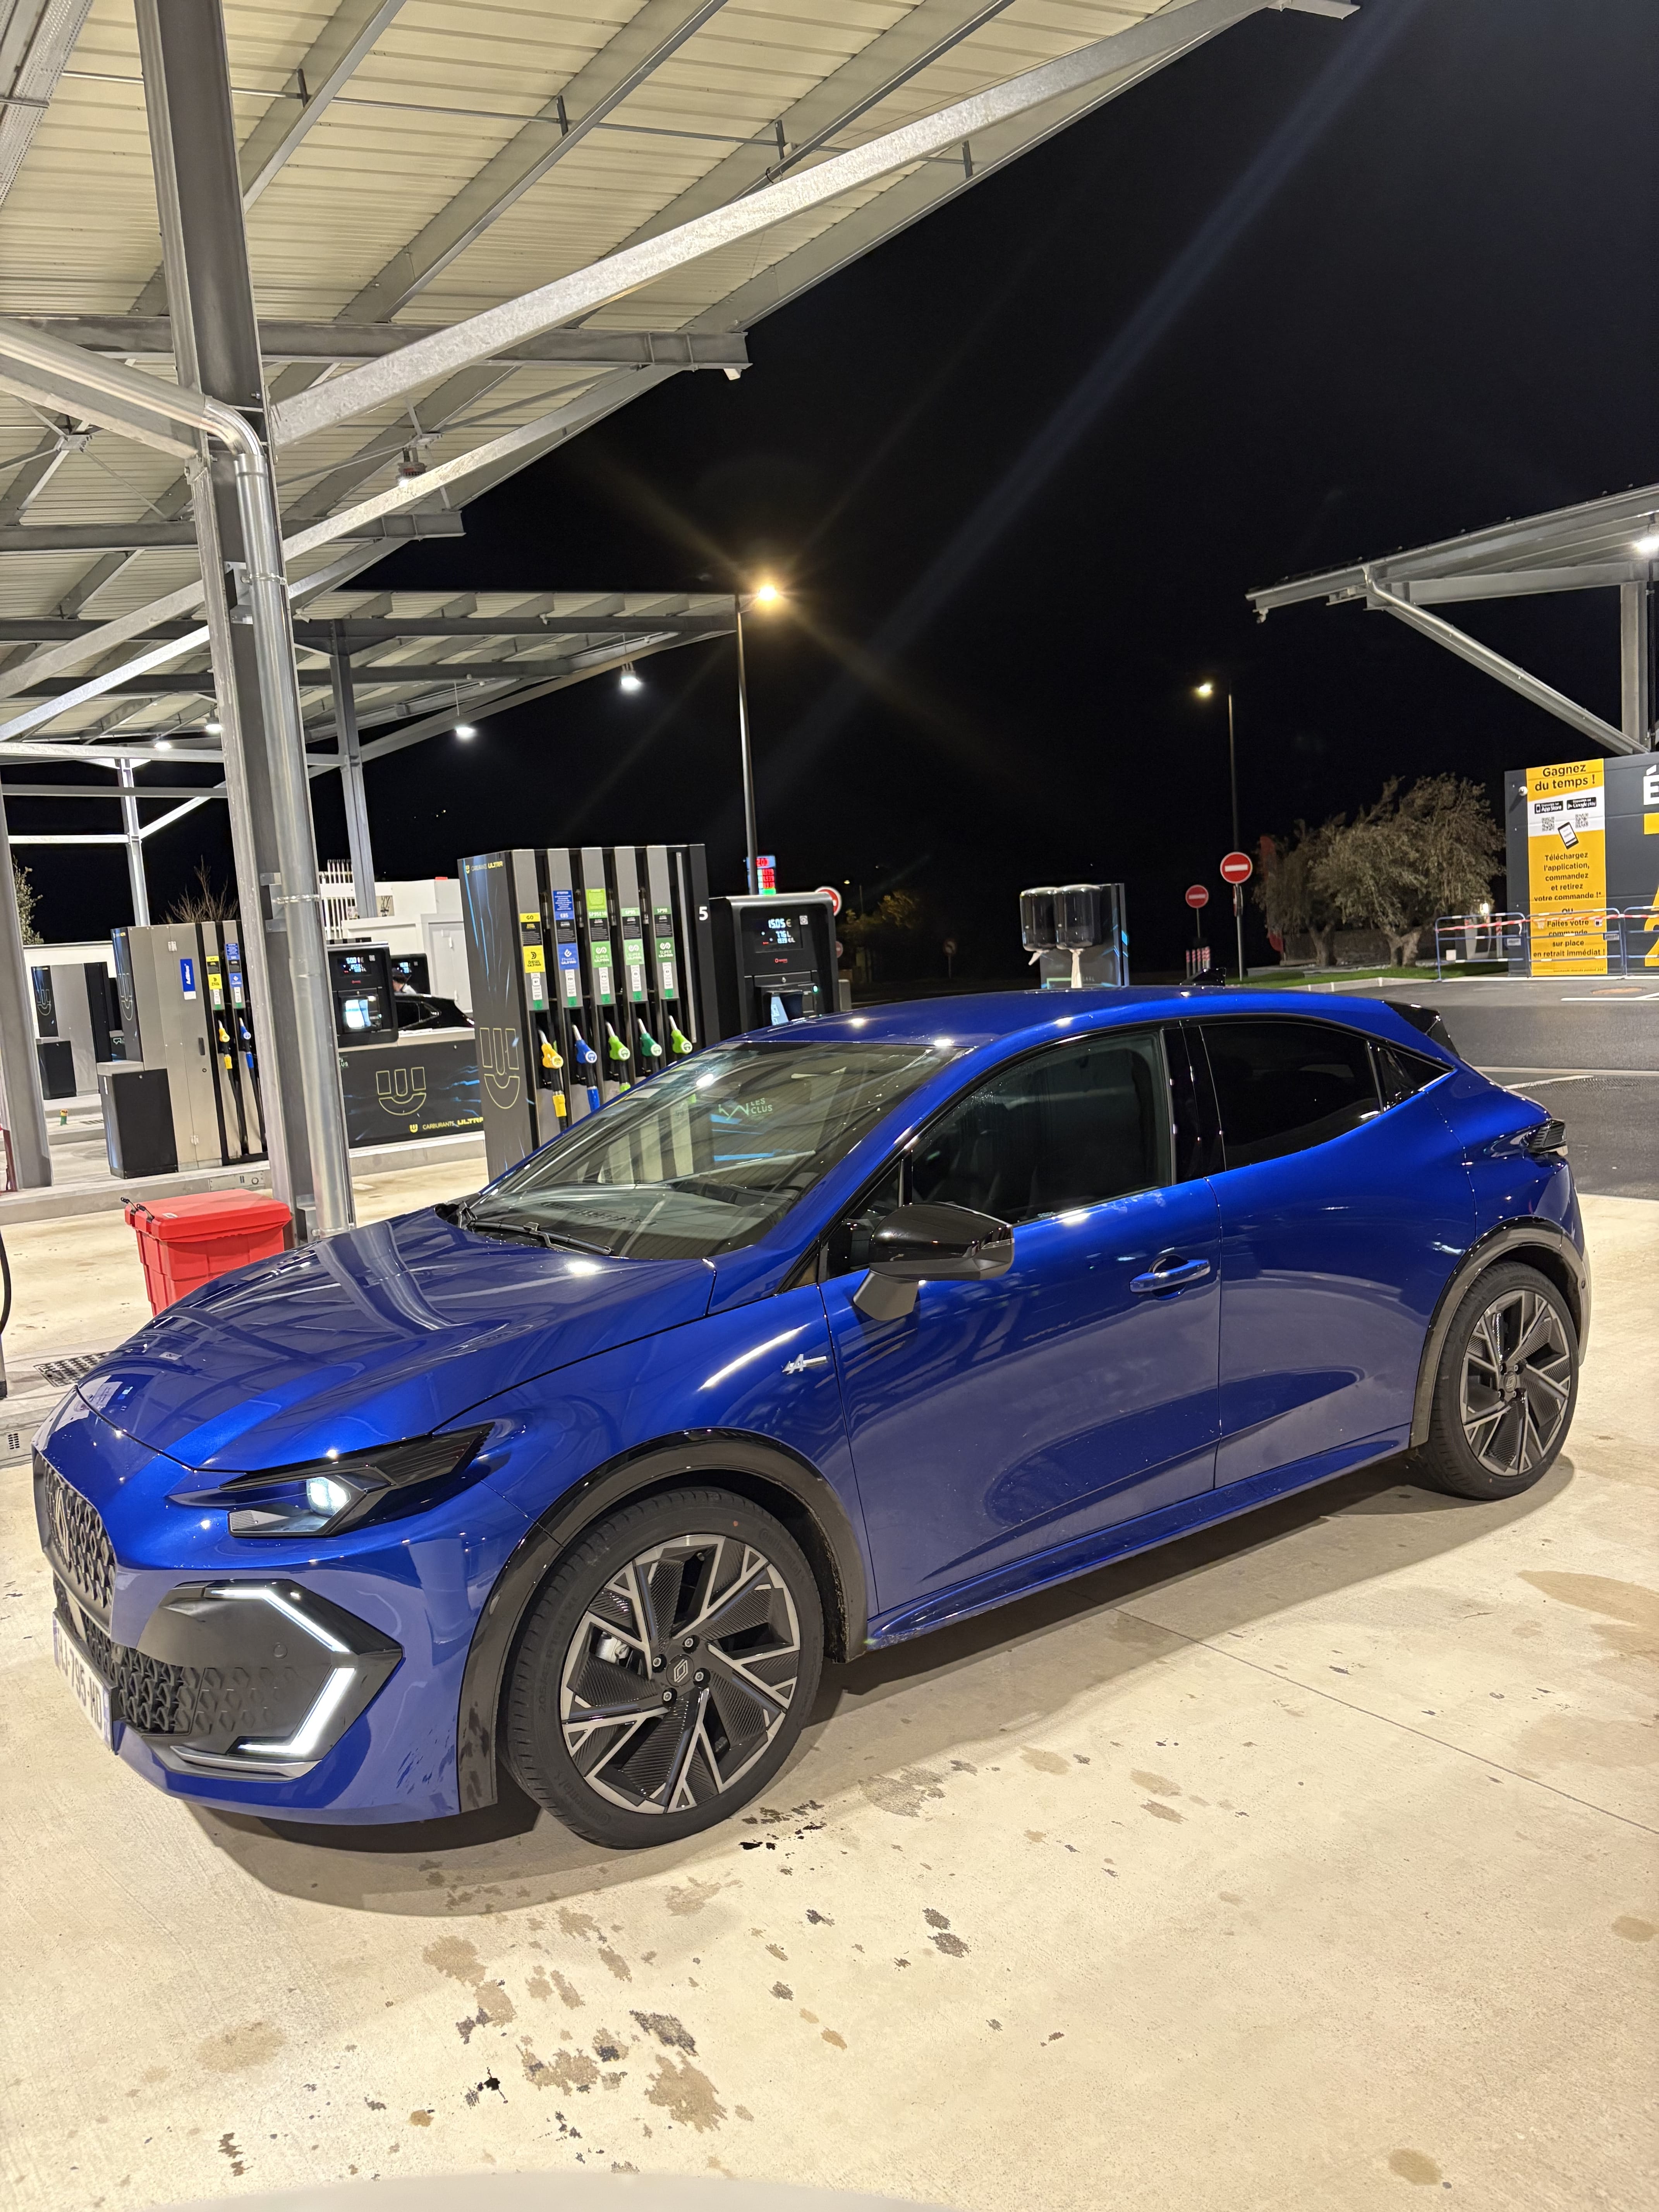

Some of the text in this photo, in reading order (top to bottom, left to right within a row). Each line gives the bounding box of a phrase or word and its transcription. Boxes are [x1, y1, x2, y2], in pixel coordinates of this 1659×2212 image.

[1543, 764, 1586, 778] Gagnez
[1535, 774, 1595, 792] du temps !
[1545, 852, 1589, 862] Téléchargez
[1544, 862, 1590, 872] l'application,
[1545, 872, 1589, 881] commandez
[1554, 892, 1594, 901] commande
[699, 906, 708, 920] 5
[1565, 939, 1584, 947] place
[422, 1121, 455, 1130] CARBURANTS
